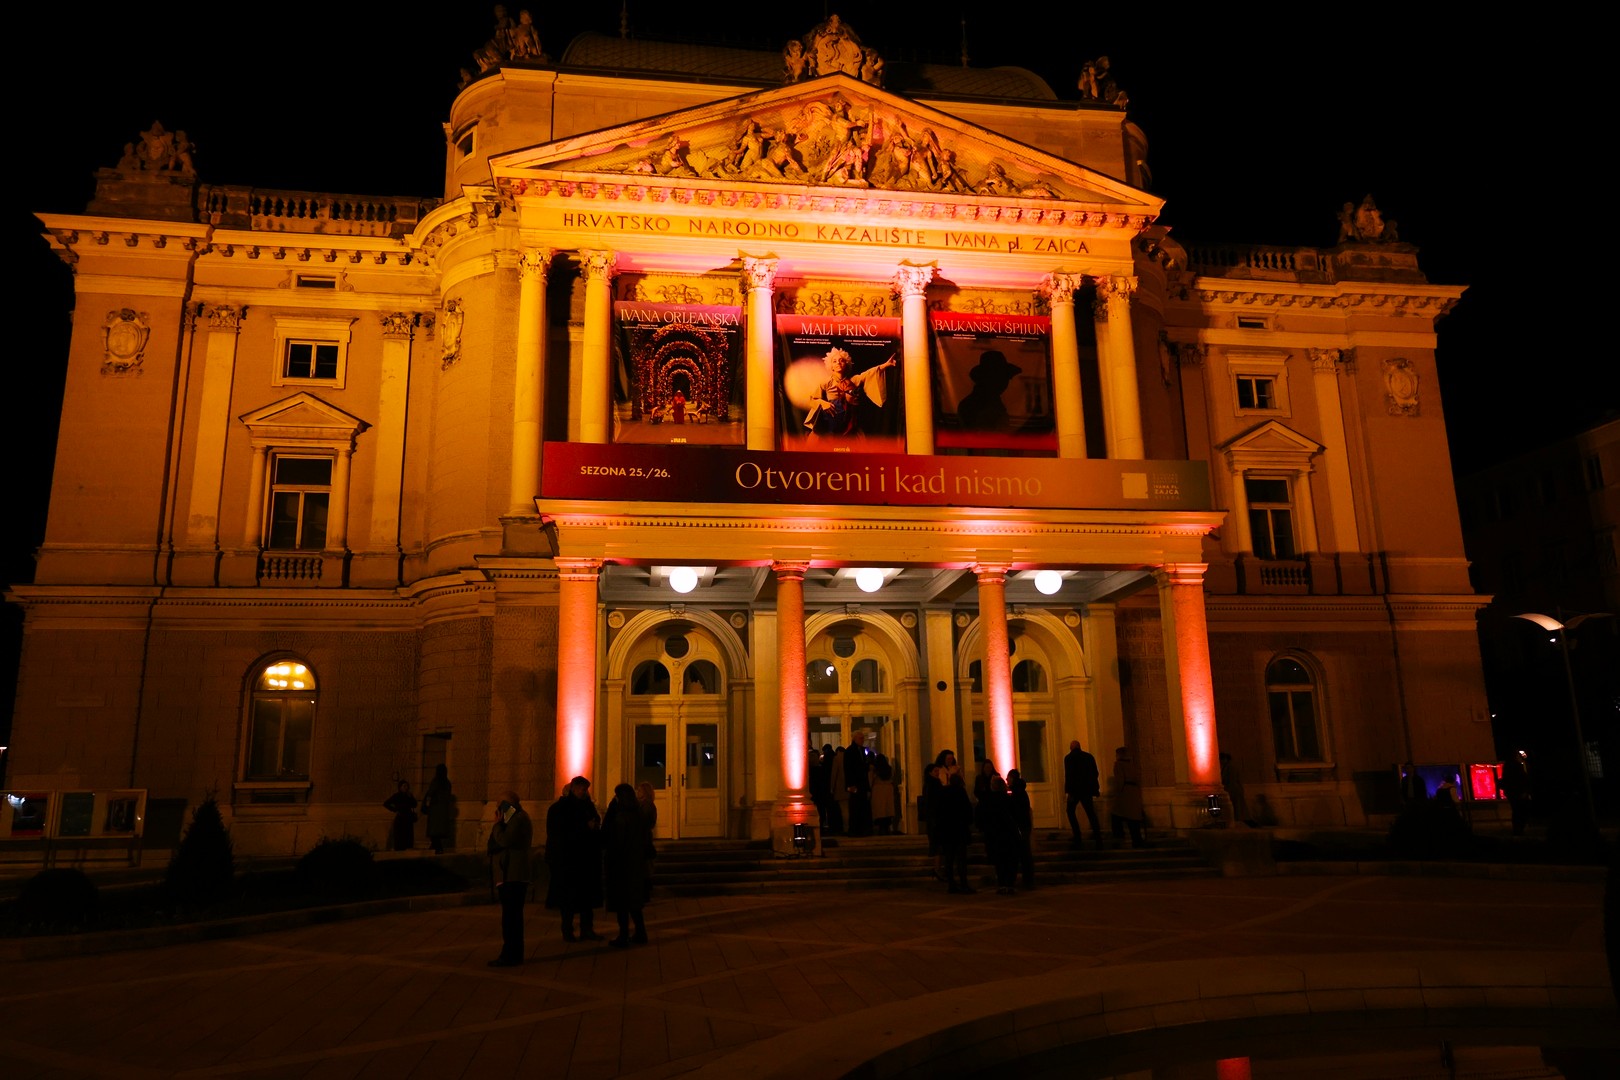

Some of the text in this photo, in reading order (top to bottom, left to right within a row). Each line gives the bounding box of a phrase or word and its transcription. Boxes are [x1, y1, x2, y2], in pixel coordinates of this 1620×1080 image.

[563, 213, 1089, 254] HRVATSKO NARODNO KAZALIŠTE IVANA pl. ZAJCA
[620, 309, 739, 326] IVANA ORLEANSKA
[801, 322, 878, 337] MALI PRINC
[934, 319, 1046, 335] BALKANSKI ŠPIJUN
[580, 465, 671, 479] SEZONA 25./26.
[735, 462, 1042, 496] Otvoreni i kad nismo
